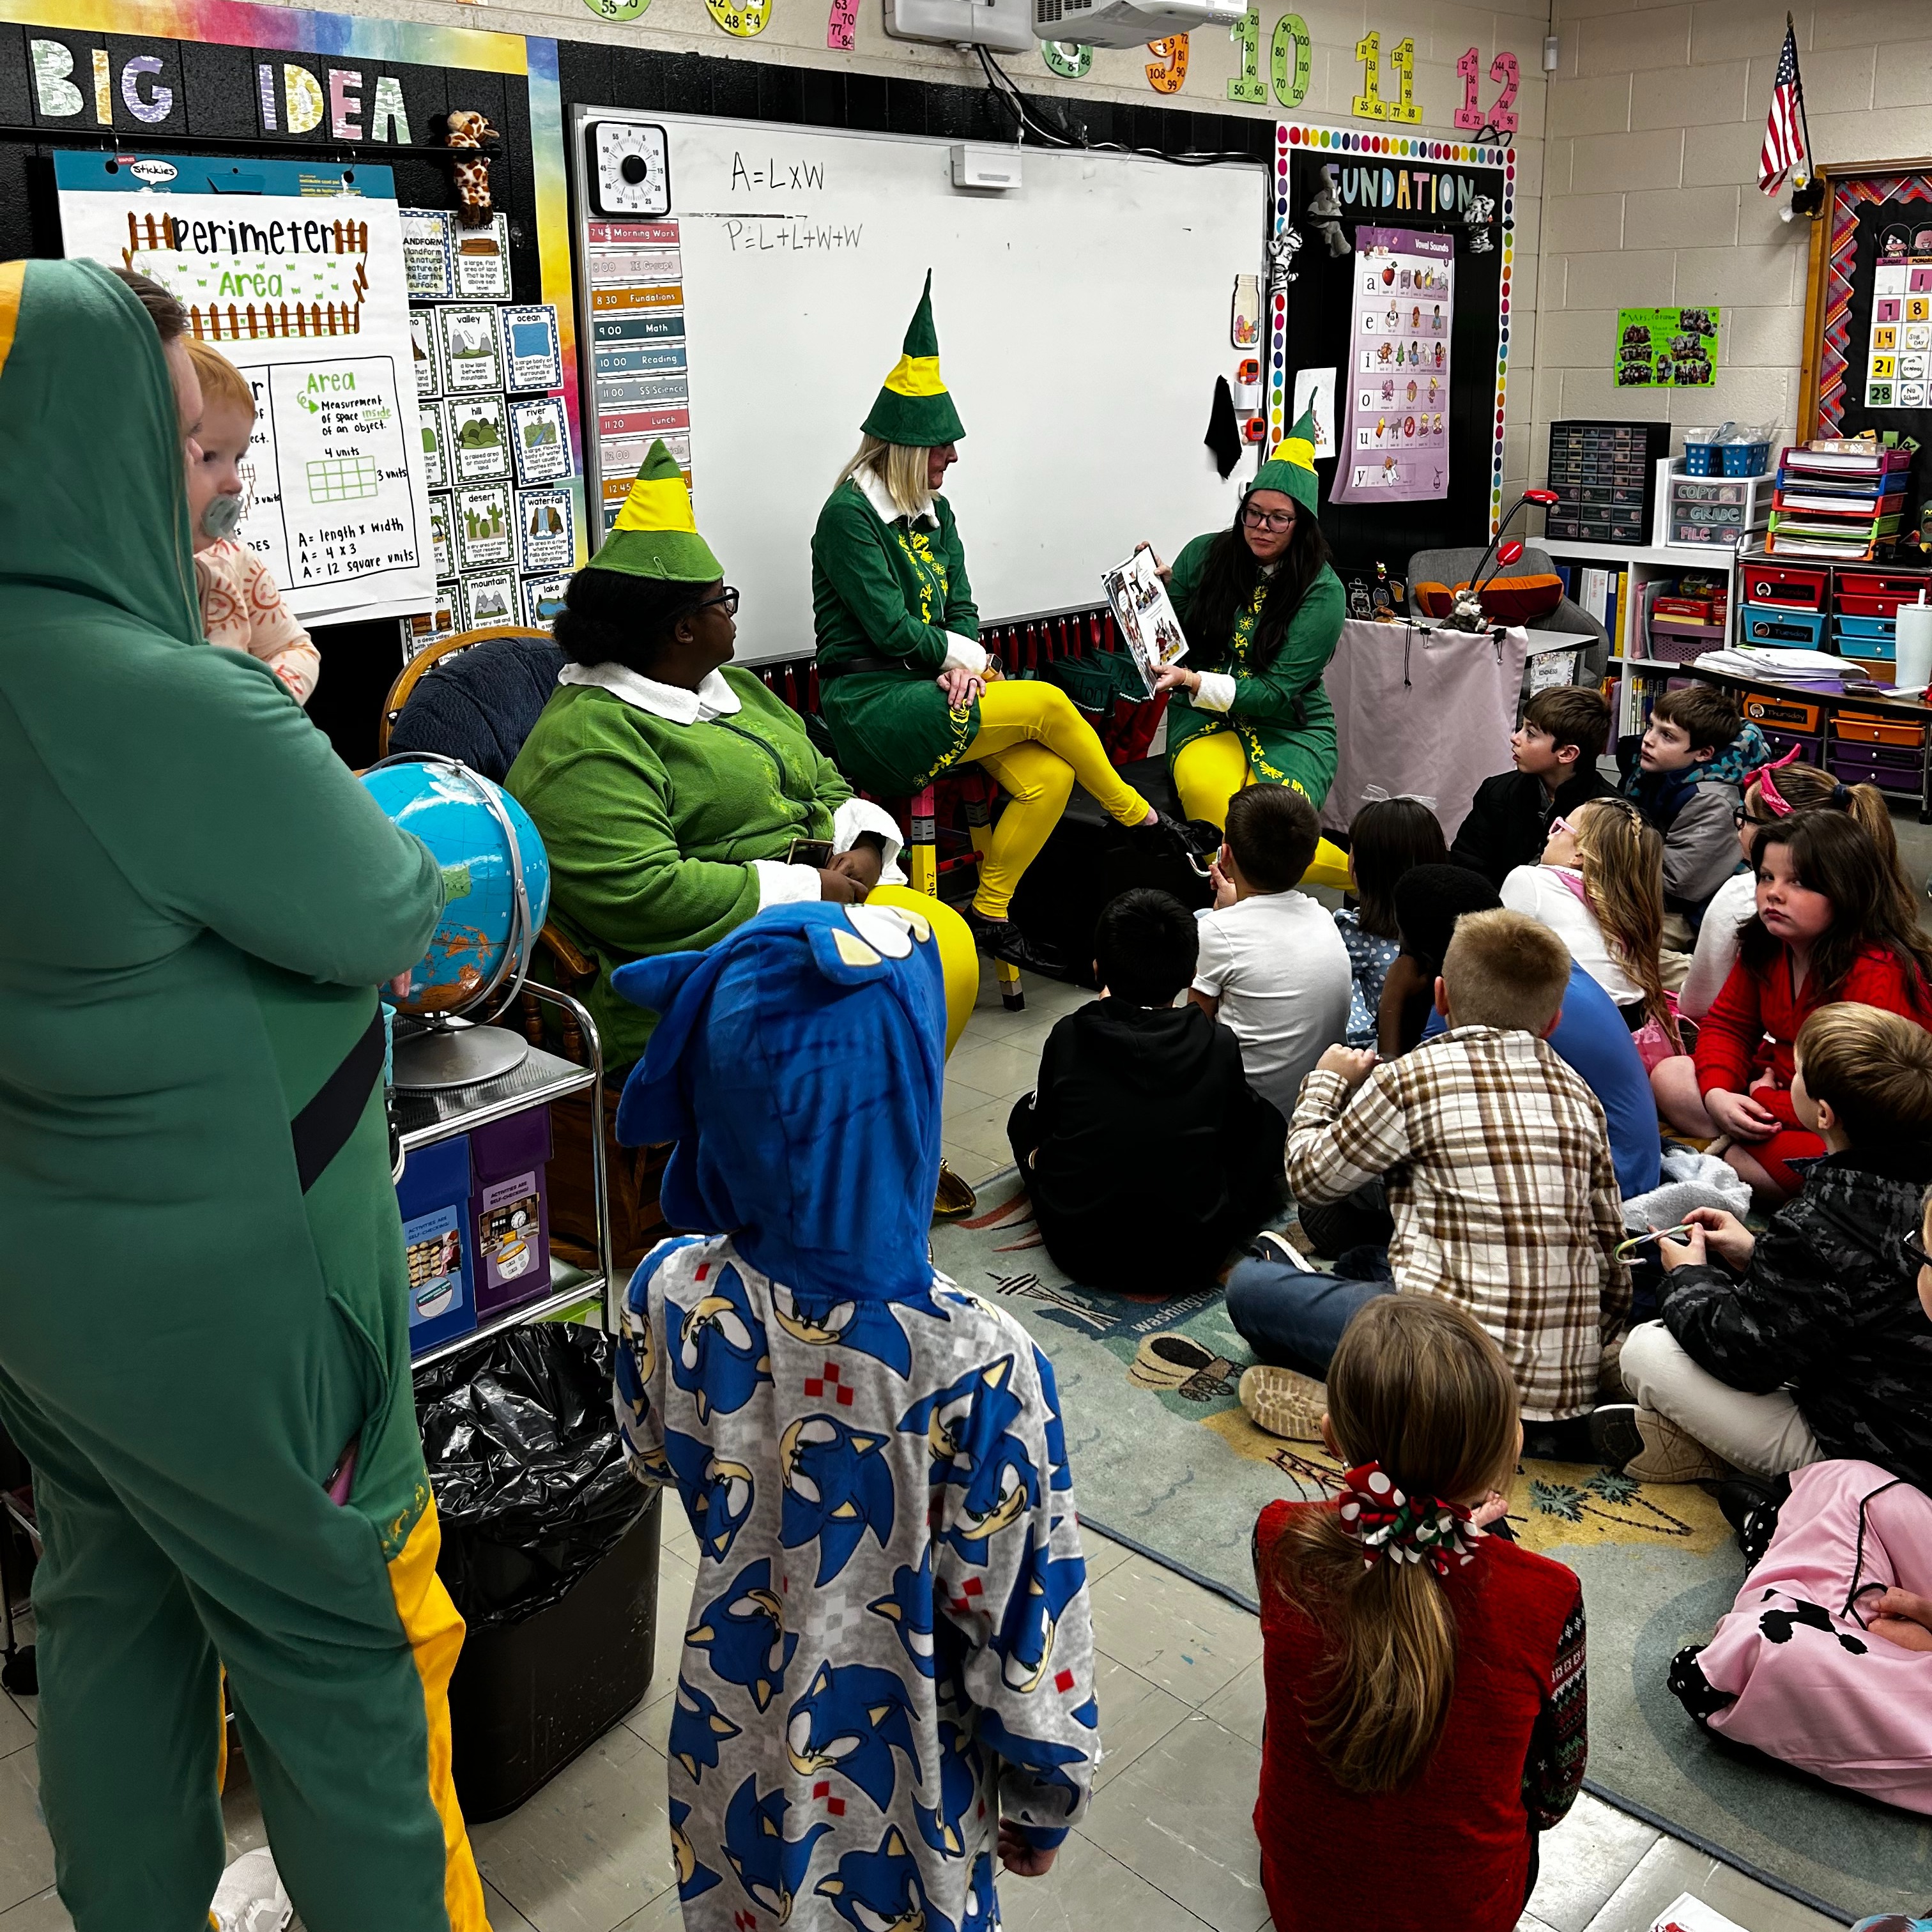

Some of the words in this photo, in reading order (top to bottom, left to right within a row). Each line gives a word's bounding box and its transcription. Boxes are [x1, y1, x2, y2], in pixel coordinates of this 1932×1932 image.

[834, 0, 847, 10] 63
[724, 15, 739, 29] 48
[746, 13, 760, 29] 54
[841, 13, 855, 26] 70
[1250, 15, 1259, 26] 20
[831, 23, 843, 36] 77
[1236, 22, 1245, 32] 10
[1281, 22, 1291, 33] 90
[841, 35, 854, 46] 84
[1297, 35, 1309, 47] 100
[1371, 40, 1378, 50] 22
[1245, 42, 1255, 52] 30
[1275, 47, 1285, 57] 80
[1361, 45, 1367, 54] 11
[1051, 53, 1062, 66] 72
[1080, 53, 1091, 66] 88
[1177, 50, 1185, 61] 81
[1393, 52, 1404, 62] 132
[1471, 55, 1478, 64] 24
[1246, 65, 1257, 77] 40
[1298, 62, 1309, 72] 110
[1368, 61, 1376, 71] 33
[1461, 61, 1468, 70] 12
[1149, 68, 1166, 79] 108
[1176, 67, 1186, 77] 90
[1167, 79, 1177, 91] 99
[1276, 77, 1286, 89] 70
[1469, 75, 1476, 84] 36
[31, 38, 173, 125] BIG
[258, 63, 412, 144] IDEA
[1234, 84, 1245, 96] 50
[1254, 86, 1264, 96] 60
[1370, 82, 1377, 93] 44
[1292, 89, 1304, 100] 120
[1404, 89, 1412, 99] 99
[1360, 101, 1368, 111] 55
[1374, 104, 1382, 114] 66
[1393, 107, 1400, 118] 77
[1407, 109, 1416, 118] 88
[1462, 113, 1469, 123] 60
[1473, 115, 1480, 125] 72
[1506, 115, 1514, 125] 96
[132, 164, 176, 176] Stickies
[614, 228, 650, 240] Morning
[652, 229, 675, 238] Work
[402, 238, 444, 246] ANDFORM
[1414, 238, 1429, 249] Vowel
[1429, 241, 1449, 252] Sounds
[643, 260, 673, 271] Groups
[218, 271, 282, 298] Area
[1367, 277, 1376, 290] a
[1920, 273, 1924, 286] 1
[630, 294, 675, 303] Fundations
[1885, 303, 1892, 316] 7
[1913, 302, 1922, 315] 8
[457, 315, 481, 325] valley
[1366, 316, 1374, 329] e
[646, 323, 668, 332] Math
[1877, 331, 1892, 344] 14
[642, 355, 677, 364] Reading
[1366, 353, 1370, 367] i
[1874, 360, 1891, 373] 21
[307, 371, 356, 394] Area
[640, 387, 650, 395] SS
[653, 385, 684, 394] Science
[1871, 387, 1890, 400] 28
[321, 394, 382, 411] Measurement
[1362, 394, 1370, 406] o
[321, 415, 332, 424] of
[335, 413, 358, 422] space
[362, 406, 392, 420] inside
[471, 407, 482, 416] hill
[526, 407, 546, 417] river
[652, 415, 676, 425] Lunch
[322, 426, 332, 436] of
[336, 425, 348, 434] an
[354, 420, 387, 434] object.
[1360, 433, 1368, 445] u
[325, 448, 333, 458] 4
[336, 447, 360, 457] units
[376, 470, 384, 481] 3
[385, 467, 407, 479] units
[1355, 470, 1365, 487] y
[262, 493, 280, 503] units
[468, 493, 495, 503] desert
[1678, 485, 1717, 500] COPY
[528, 496, 564, 506] waterfall
[298, 533, 307, 547] A
[319, 525, 356, 543] length
[371, 518, 404, 533] width
[301, 551, 309, 564] A
[326, 546, 334, 558] 4
[349, 543, 356, 555] 3
[303, 567, 312, 578] A
[327, 563, 340, 575] 12
[346, 555, 381, 572] square
[387, 549, 414, 563] units
[470, 577, 507, 589] mountain
[544, 584, 560, 594] lake
[1777, 587, 1809, 597] Monday
[1774, 627, 1809, 639] Tuesday
[1767, 709, 1805, 721] Thursday
[491, 1184, 517, 1198] ACTIVITIES
[408, 1220, 436, 1234] ACTIVITIES
[1130, 1285, 1223, 1332] washington
